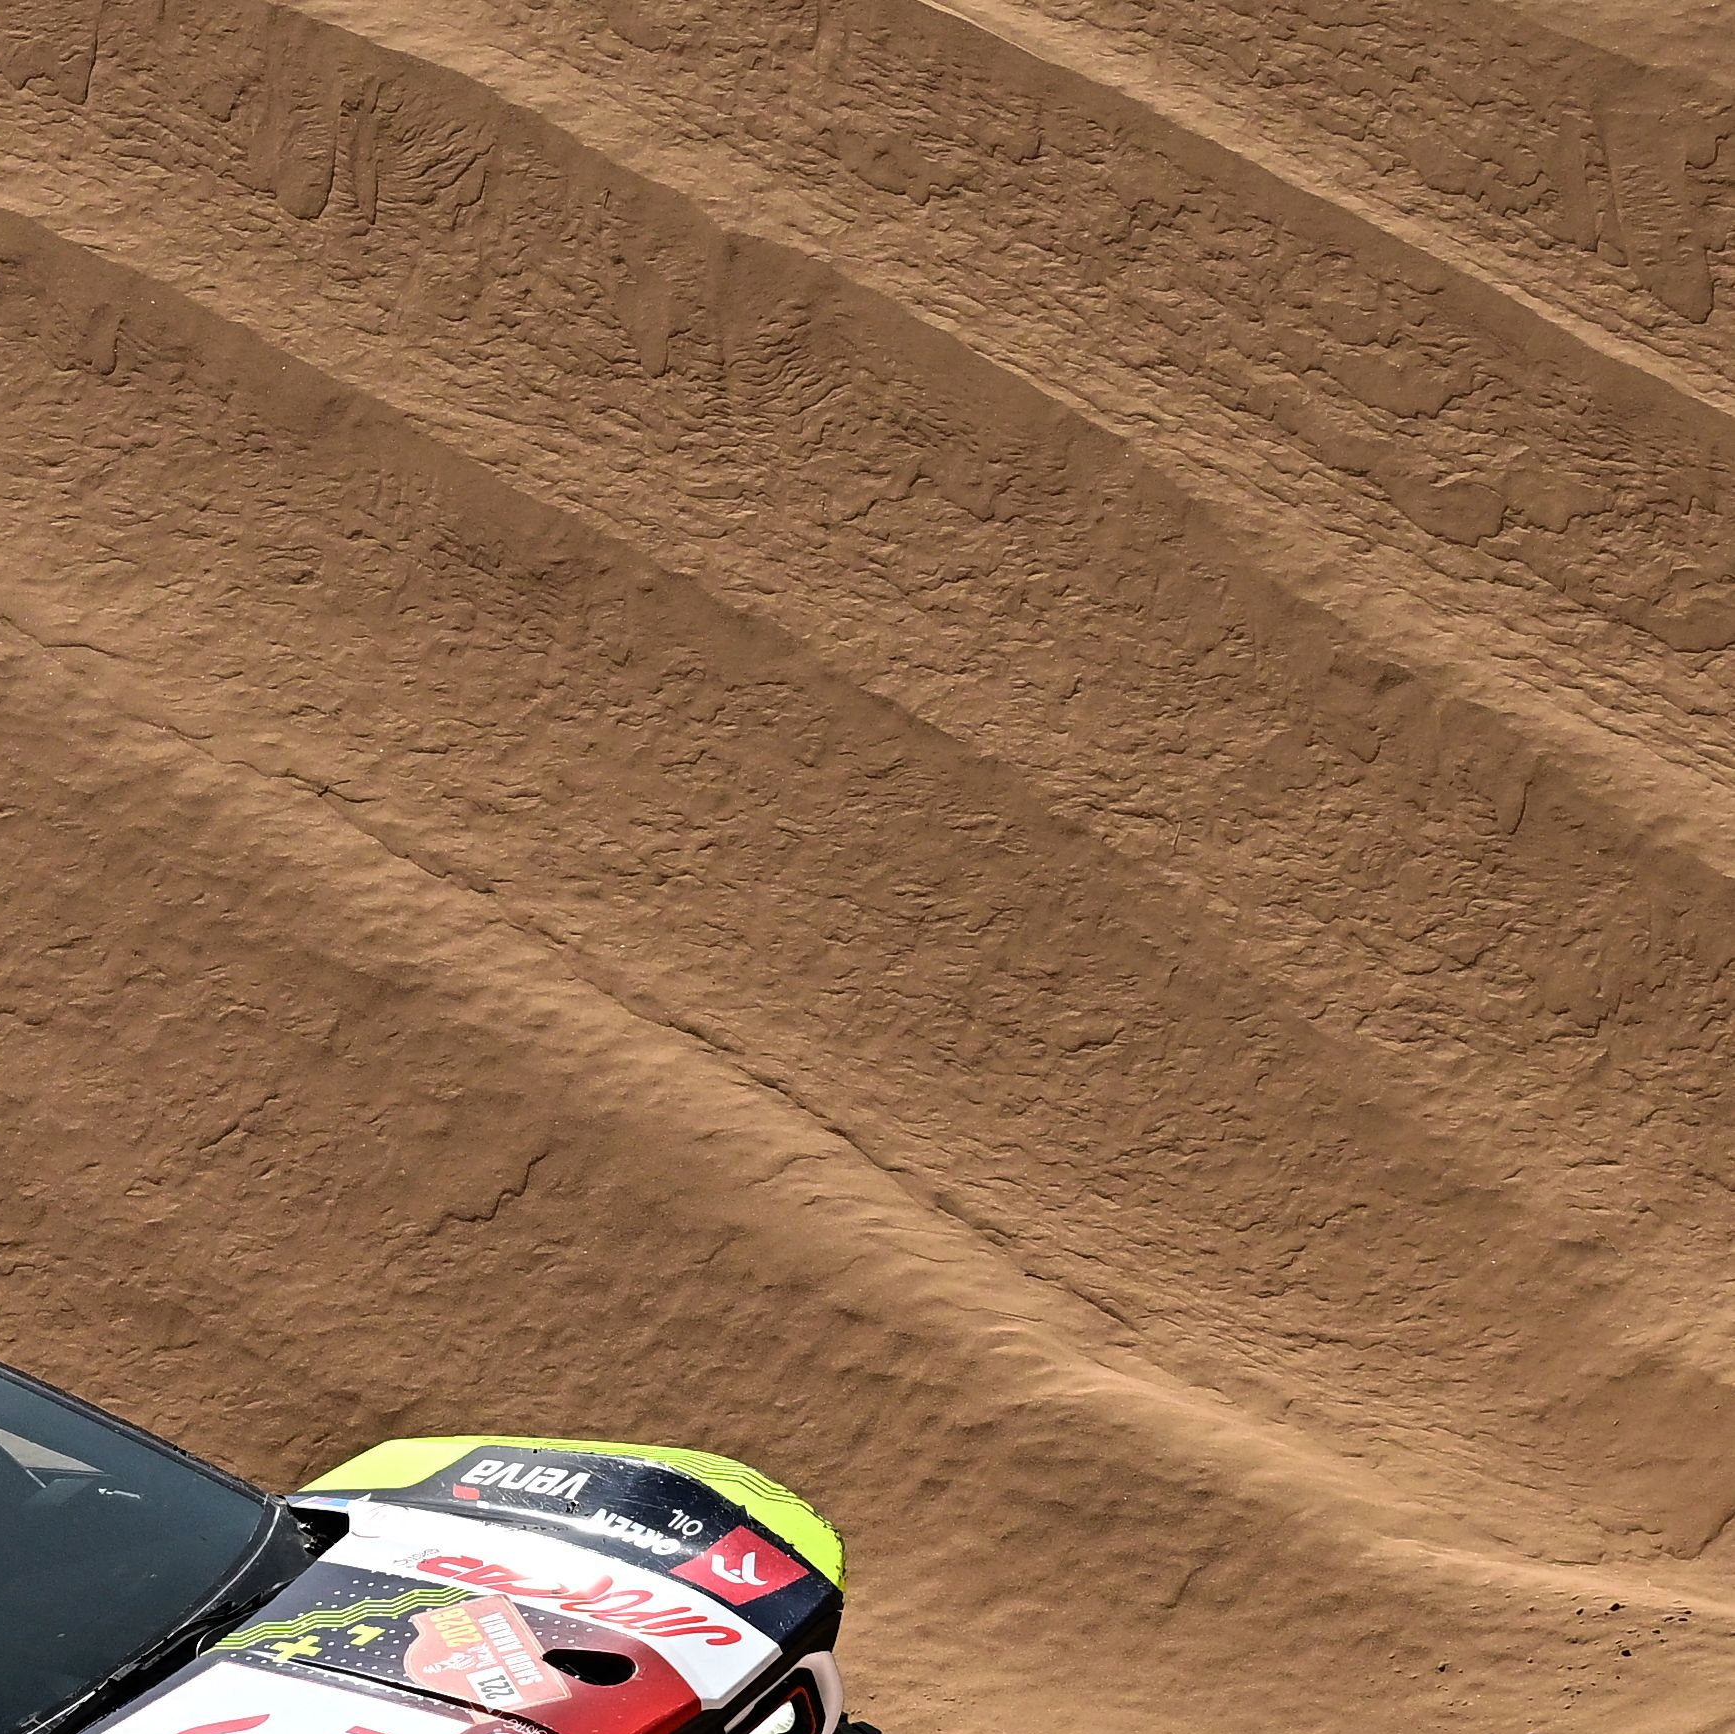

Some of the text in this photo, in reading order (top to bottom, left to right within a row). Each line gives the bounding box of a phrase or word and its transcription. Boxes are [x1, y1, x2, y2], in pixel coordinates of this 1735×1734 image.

[590, 1507, 681, 1556] ORLEN
[672, 1508, 703, 1537] OIL
[478, 1611, 544, 1686] SAUDI ARABIA
[477, 1675, 515, 1700] 221
